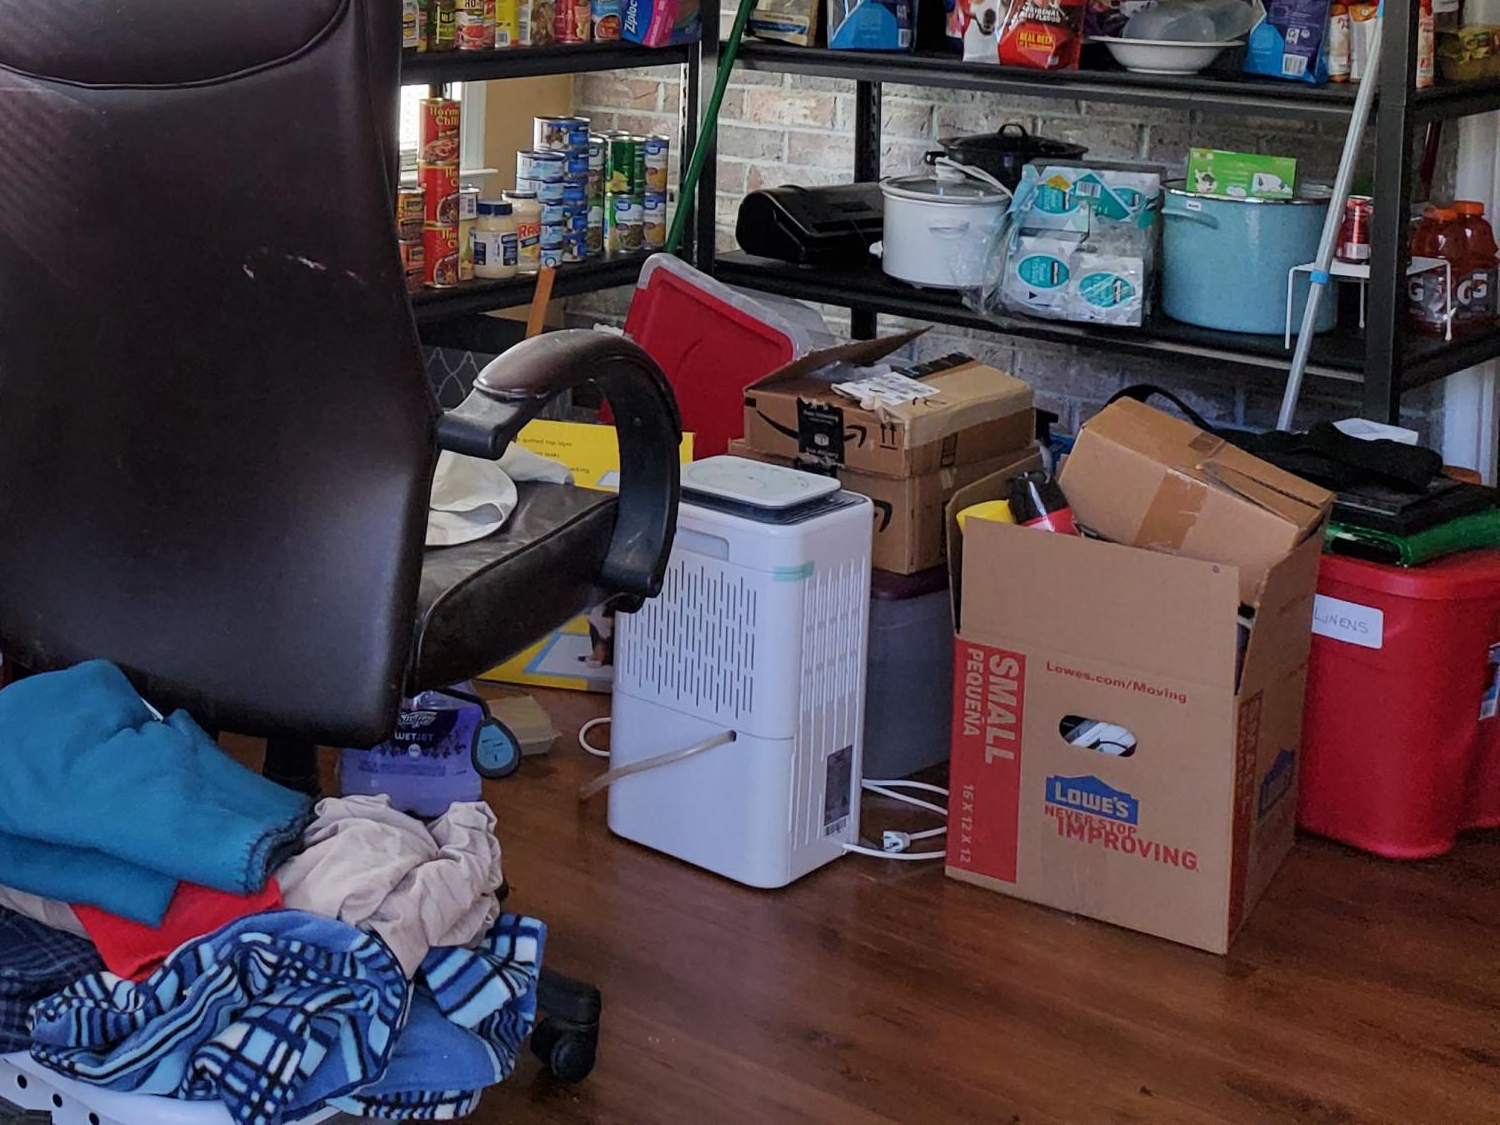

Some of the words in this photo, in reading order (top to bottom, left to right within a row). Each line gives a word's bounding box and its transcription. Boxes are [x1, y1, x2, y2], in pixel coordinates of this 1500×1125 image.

[623, 0, 639, 35] Ziploc
[1045, 660, 1189, 705] Lowes.com/Moving
[985, 653, 1020, 765] SMALL
[963, 783, 975, 801] 16
[1054, 780, 1129, 819] LOWE'S
[961, 815, 975, 832] 12
[1043, 803, 1093, 827] NEVER
[1097, 817, 1137, 838] STOP
[960, 847, 972, 864] 12
[1056, 816, 1200, 873] IMPROVING
